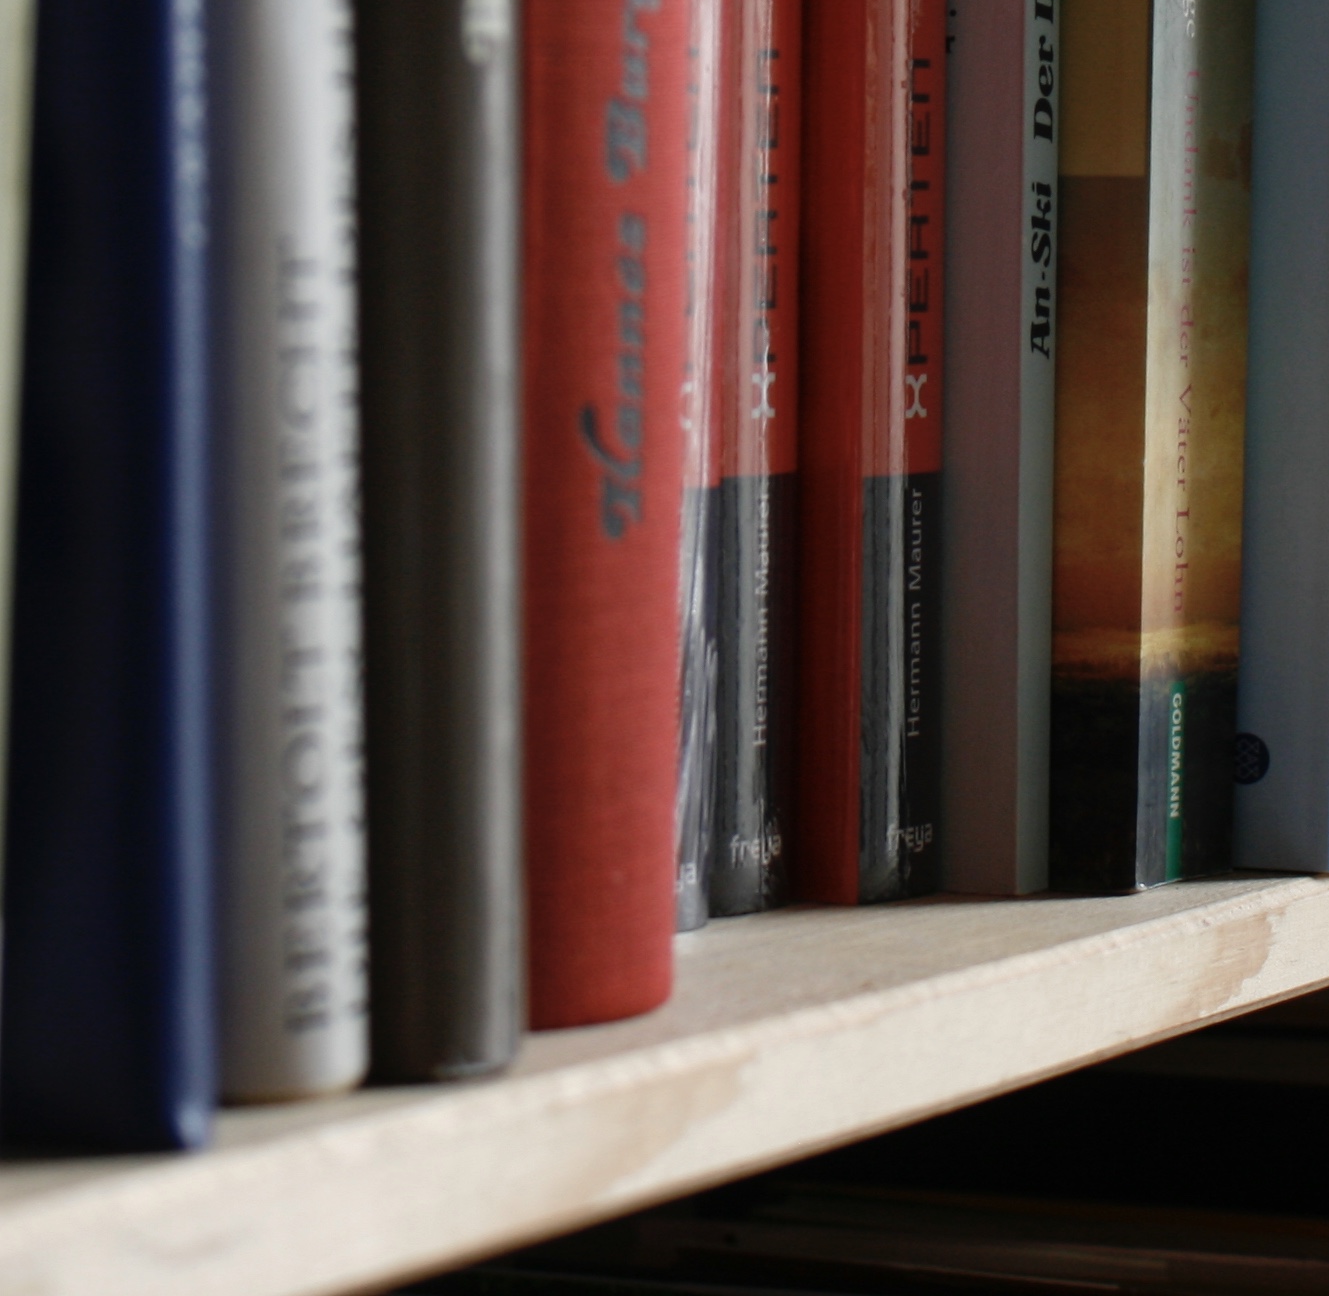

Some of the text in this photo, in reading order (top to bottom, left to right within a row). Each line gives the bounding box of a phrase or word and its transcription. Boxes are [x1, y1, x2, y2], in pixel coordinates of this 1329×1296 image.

[1032, 35, 1055, 144] Der
[1029, 181, 1053, 360] An-Ski
[1173, 68, 1201, 614] Undank ist der Väter Lohn
[577, 211, 647, 540] Hannes
[276, 236, 335, 1037] BERTOLT BRECHT
[752, 609, 768, 747] Hermann
[907, 488, 923, 739] Hermann Maurer
[887, 823, 934, 853] freya
[1169, 692, 1183, 819] GOLDMANN
